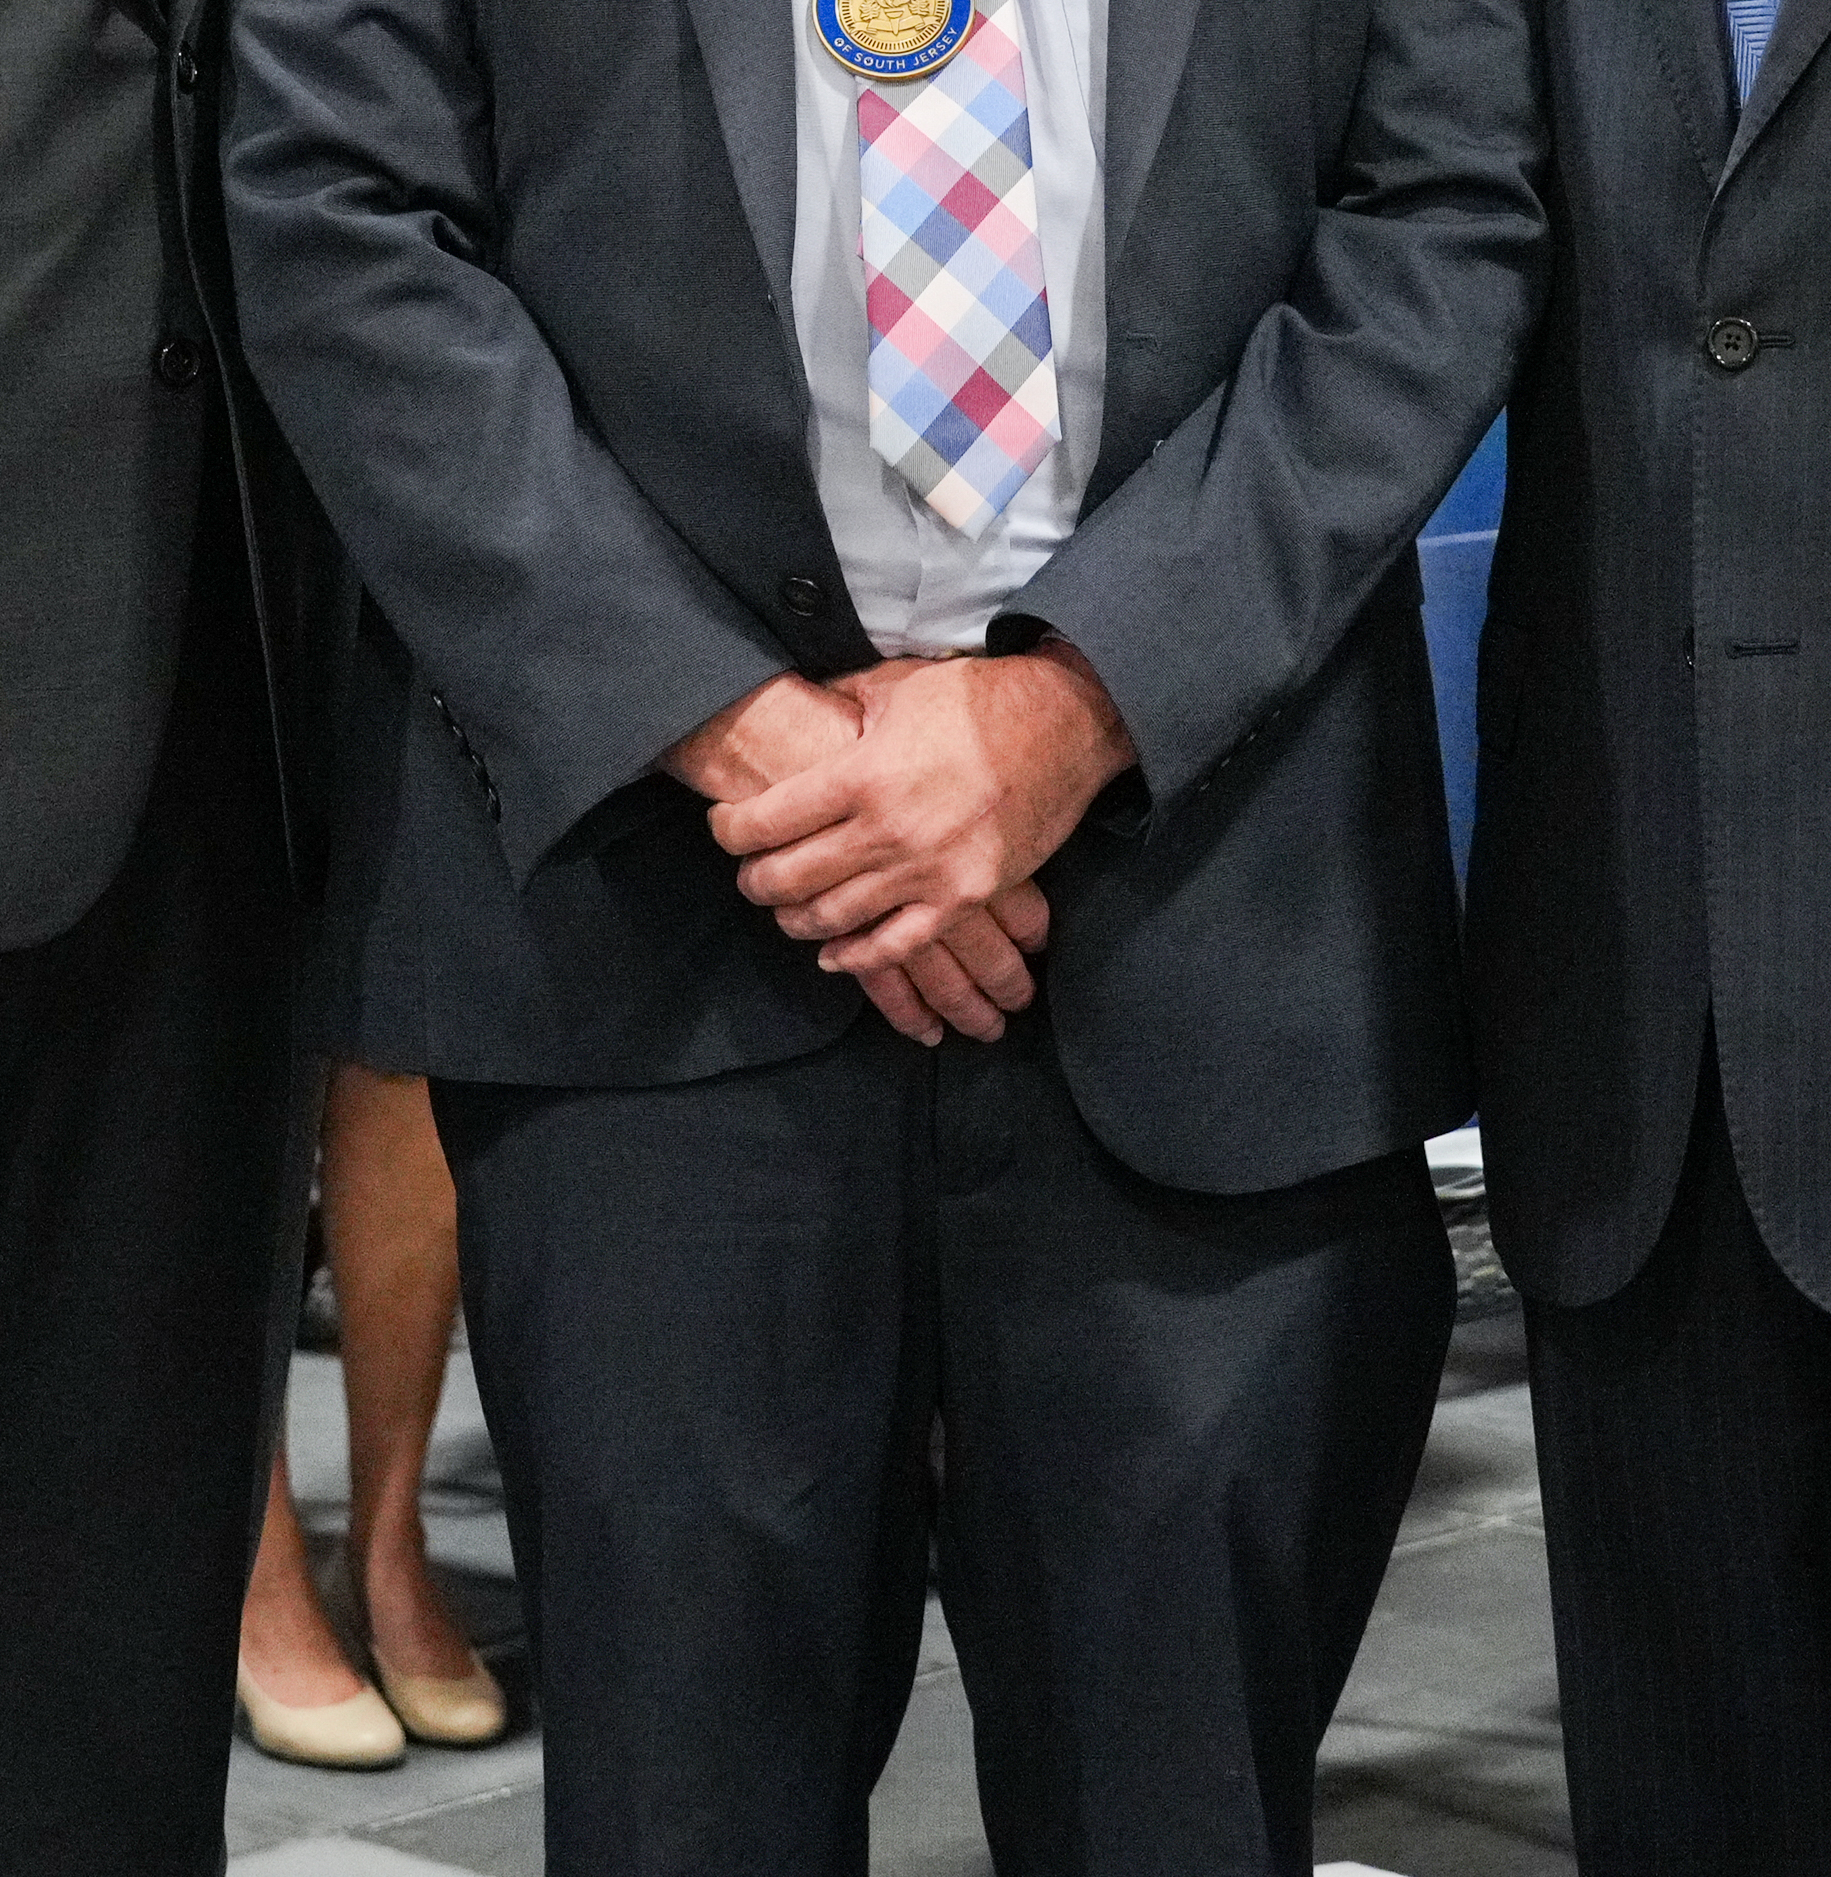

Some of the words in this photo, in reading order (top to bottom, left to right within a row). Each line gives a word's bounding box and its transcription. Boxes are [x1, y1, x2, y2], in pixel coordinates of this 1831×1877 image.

[833, 37, 853, 53] OF
[853, 51, 907, 70] SOUTH
[912, 26, 959, 67] JERSEY
